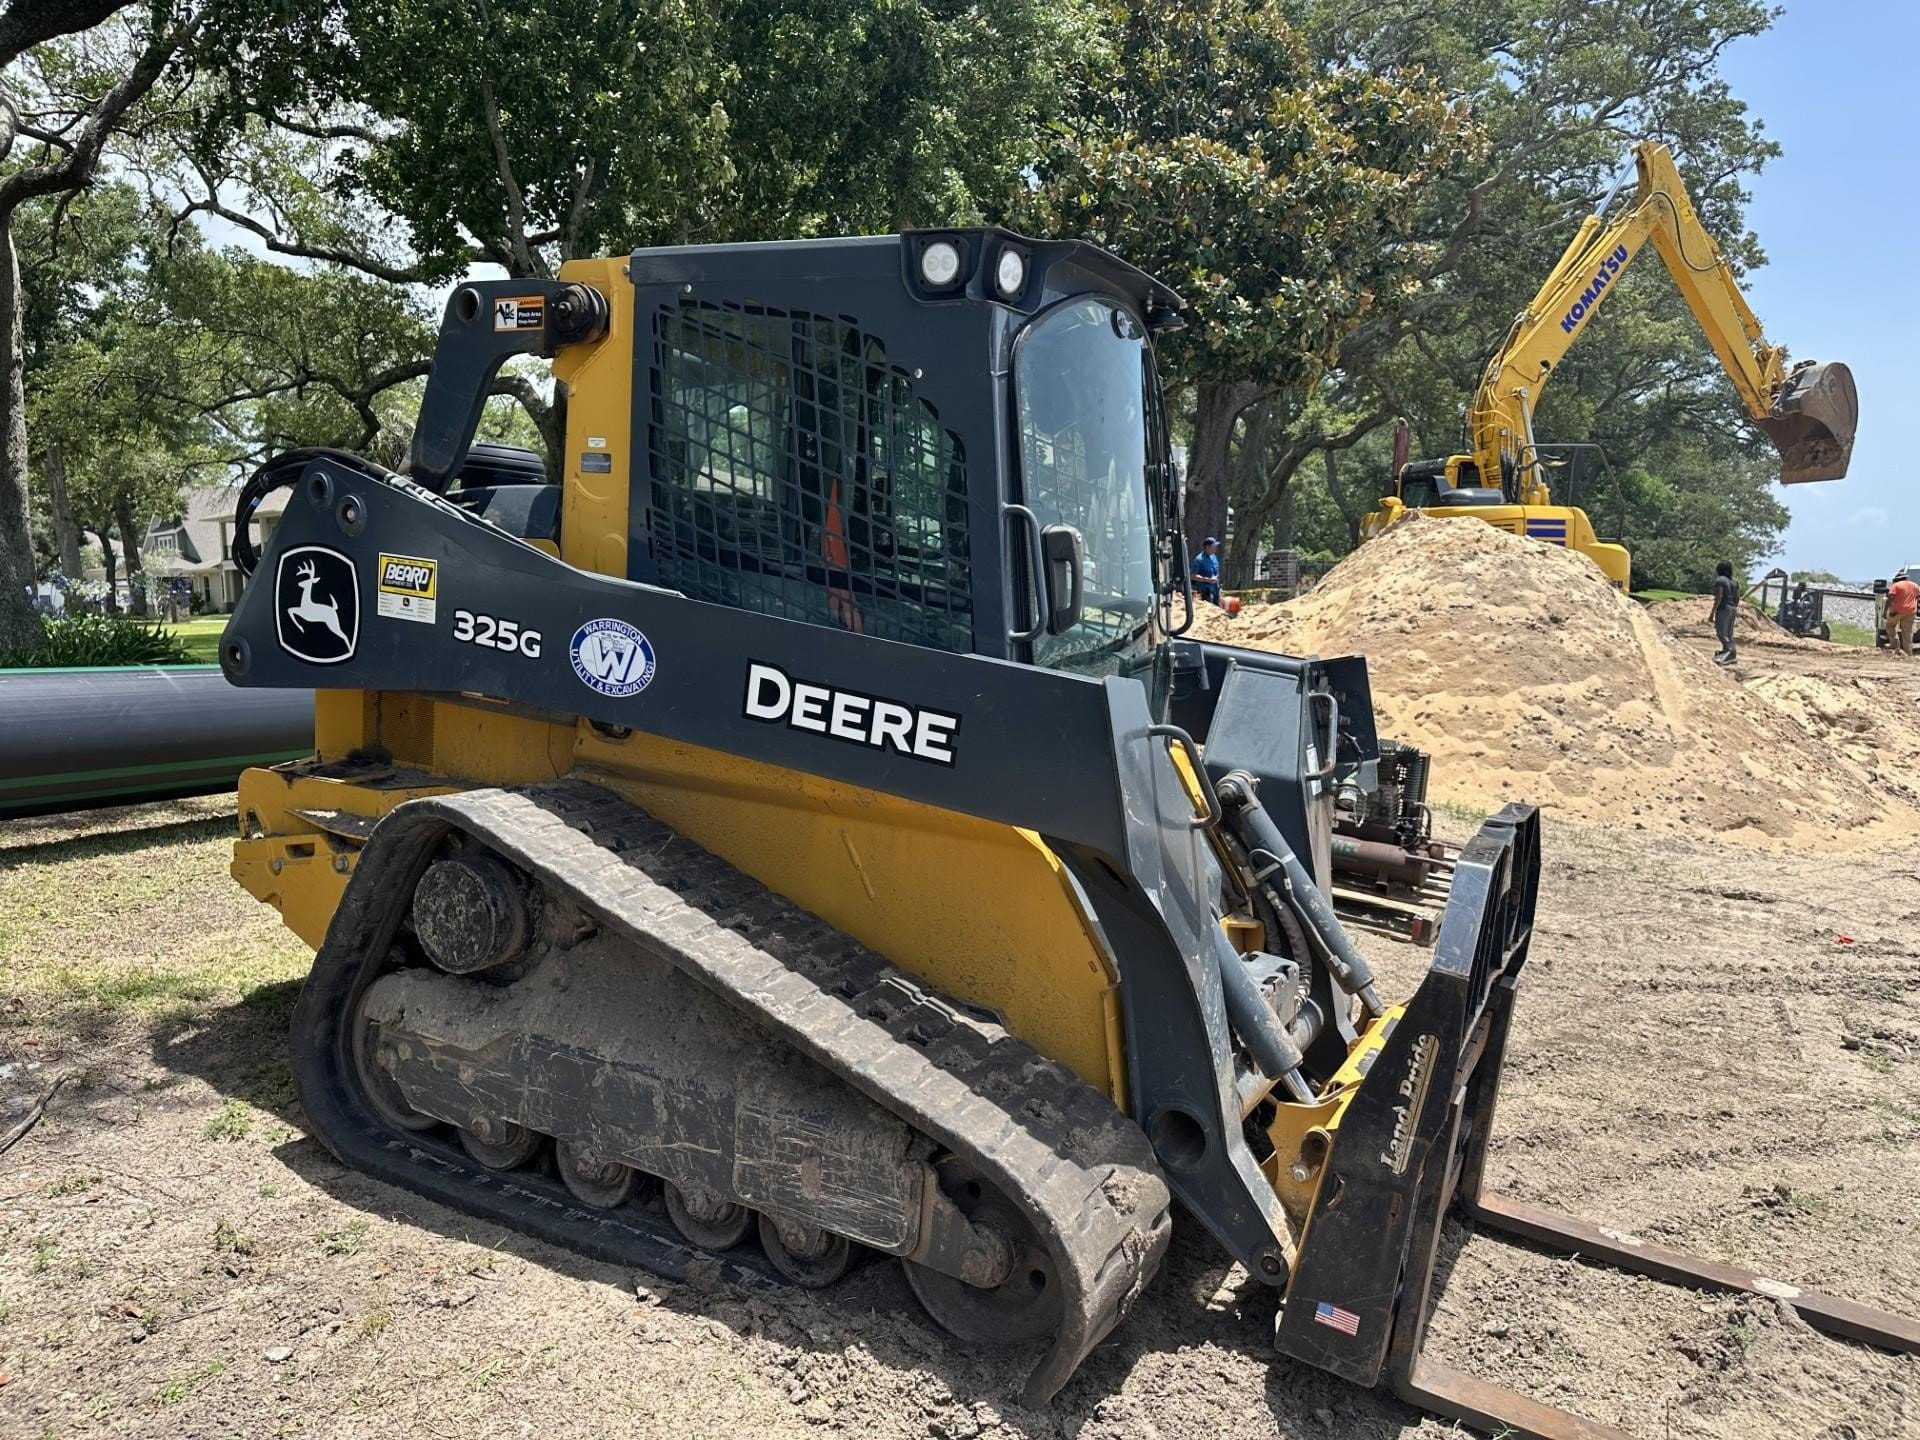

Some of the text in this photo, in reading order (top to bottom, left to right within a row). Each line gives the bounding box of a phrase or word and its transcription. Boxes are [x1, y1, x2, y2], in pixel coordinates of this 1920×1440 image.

[1560, 244, 1628, 334] KOMATSU
[386, 563, 430, 592] BEARD
[453, 610, 542, 659] 325G
[583, 620, 644, 646] WARRINGTON
[571, 648, 597, 686] UTILITY
[596, 681, 604, 691] &
[745, 663, 957, 763] DEERE
[1380, 1033, 1434, 1170] Land Pride
